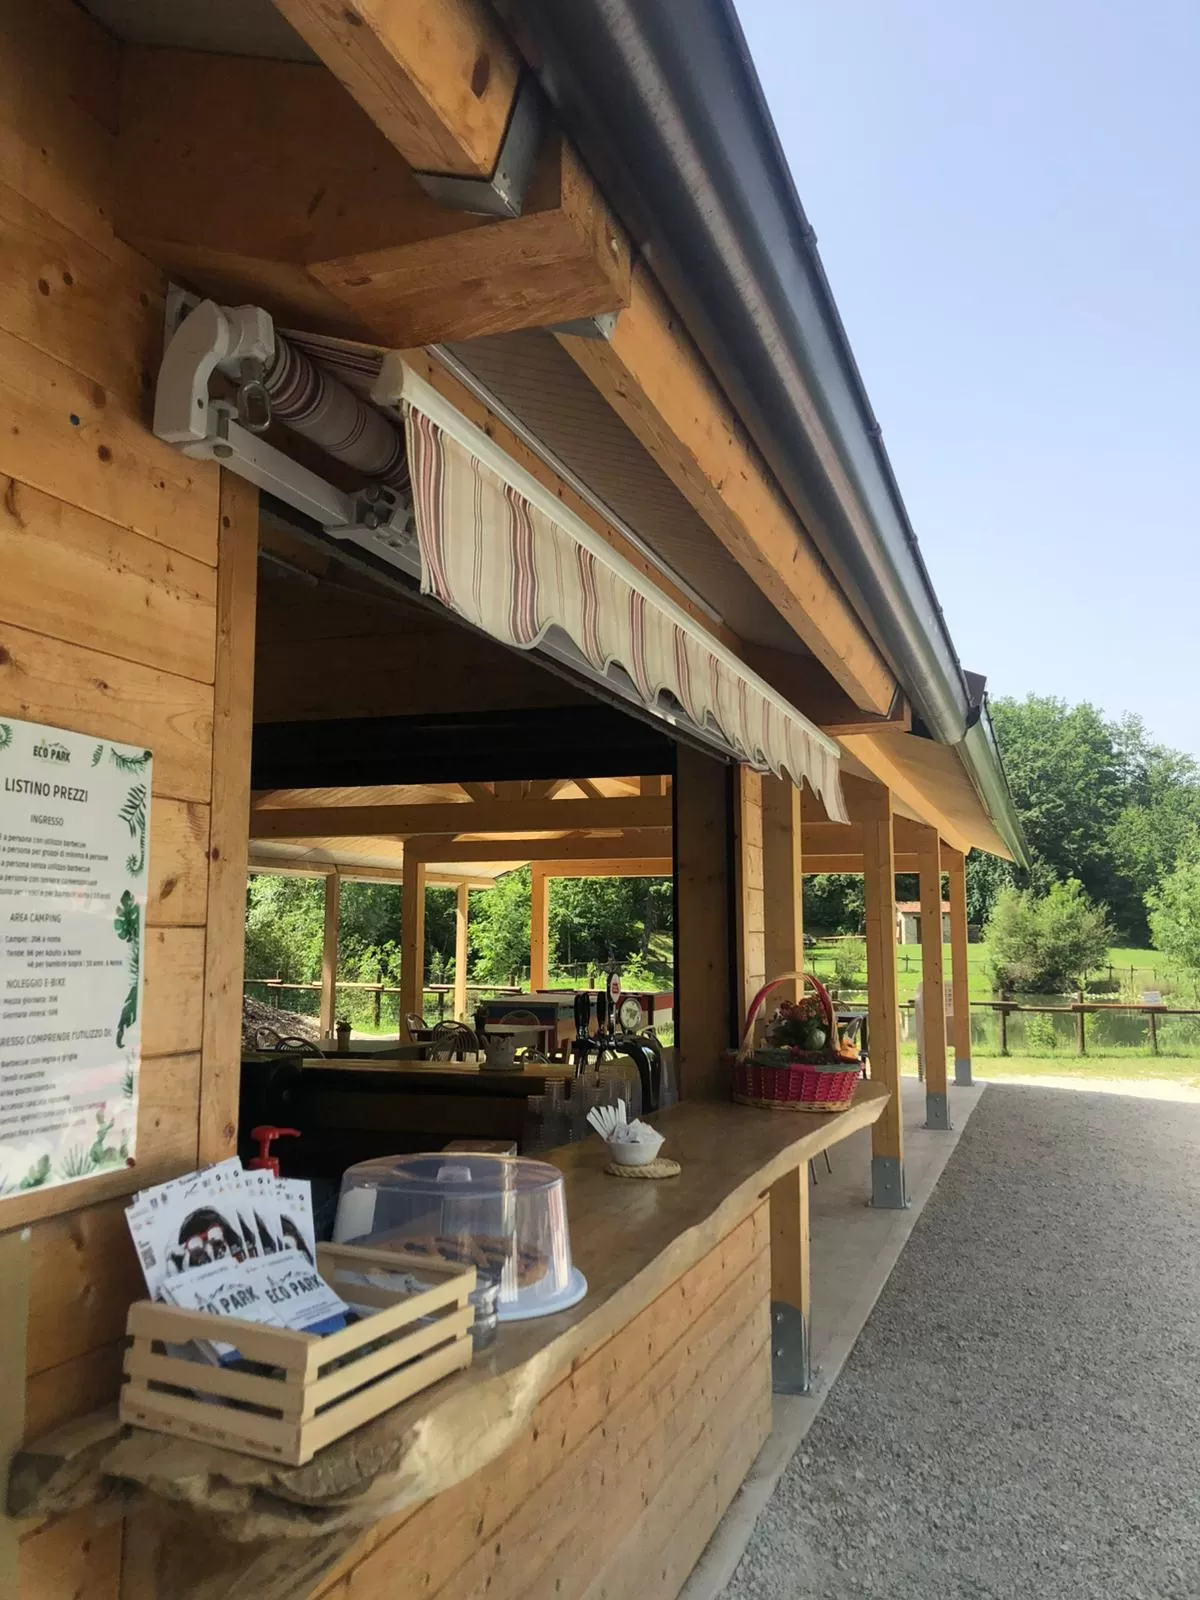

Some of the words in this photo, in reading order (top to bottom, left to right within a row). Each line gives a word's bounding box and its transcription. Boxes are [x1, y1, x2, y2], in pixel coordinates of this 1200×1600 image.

[33, 745, 48, 758] ECO
[51, 748, 71, 763] PARK
[5, 777, 50, 797] LISTINO
[53, 784, 88, 803] PREZZI
[30, 814, 64, 826] INGRESSO
[10, 912, 28, 922] AREA
[30, 913, 62, 923] CAMPING
[6, 978, 43, 989] NOLEGGIO
[44, 977, 66, 987] E-BIKE
[26, 1032, 70, 1045] COMPRENDE
[265, 1283, 291, 1305] ECO
[290, 1274, 325, 1294] PARK
[220, 1286, 260, 1314] PARK
